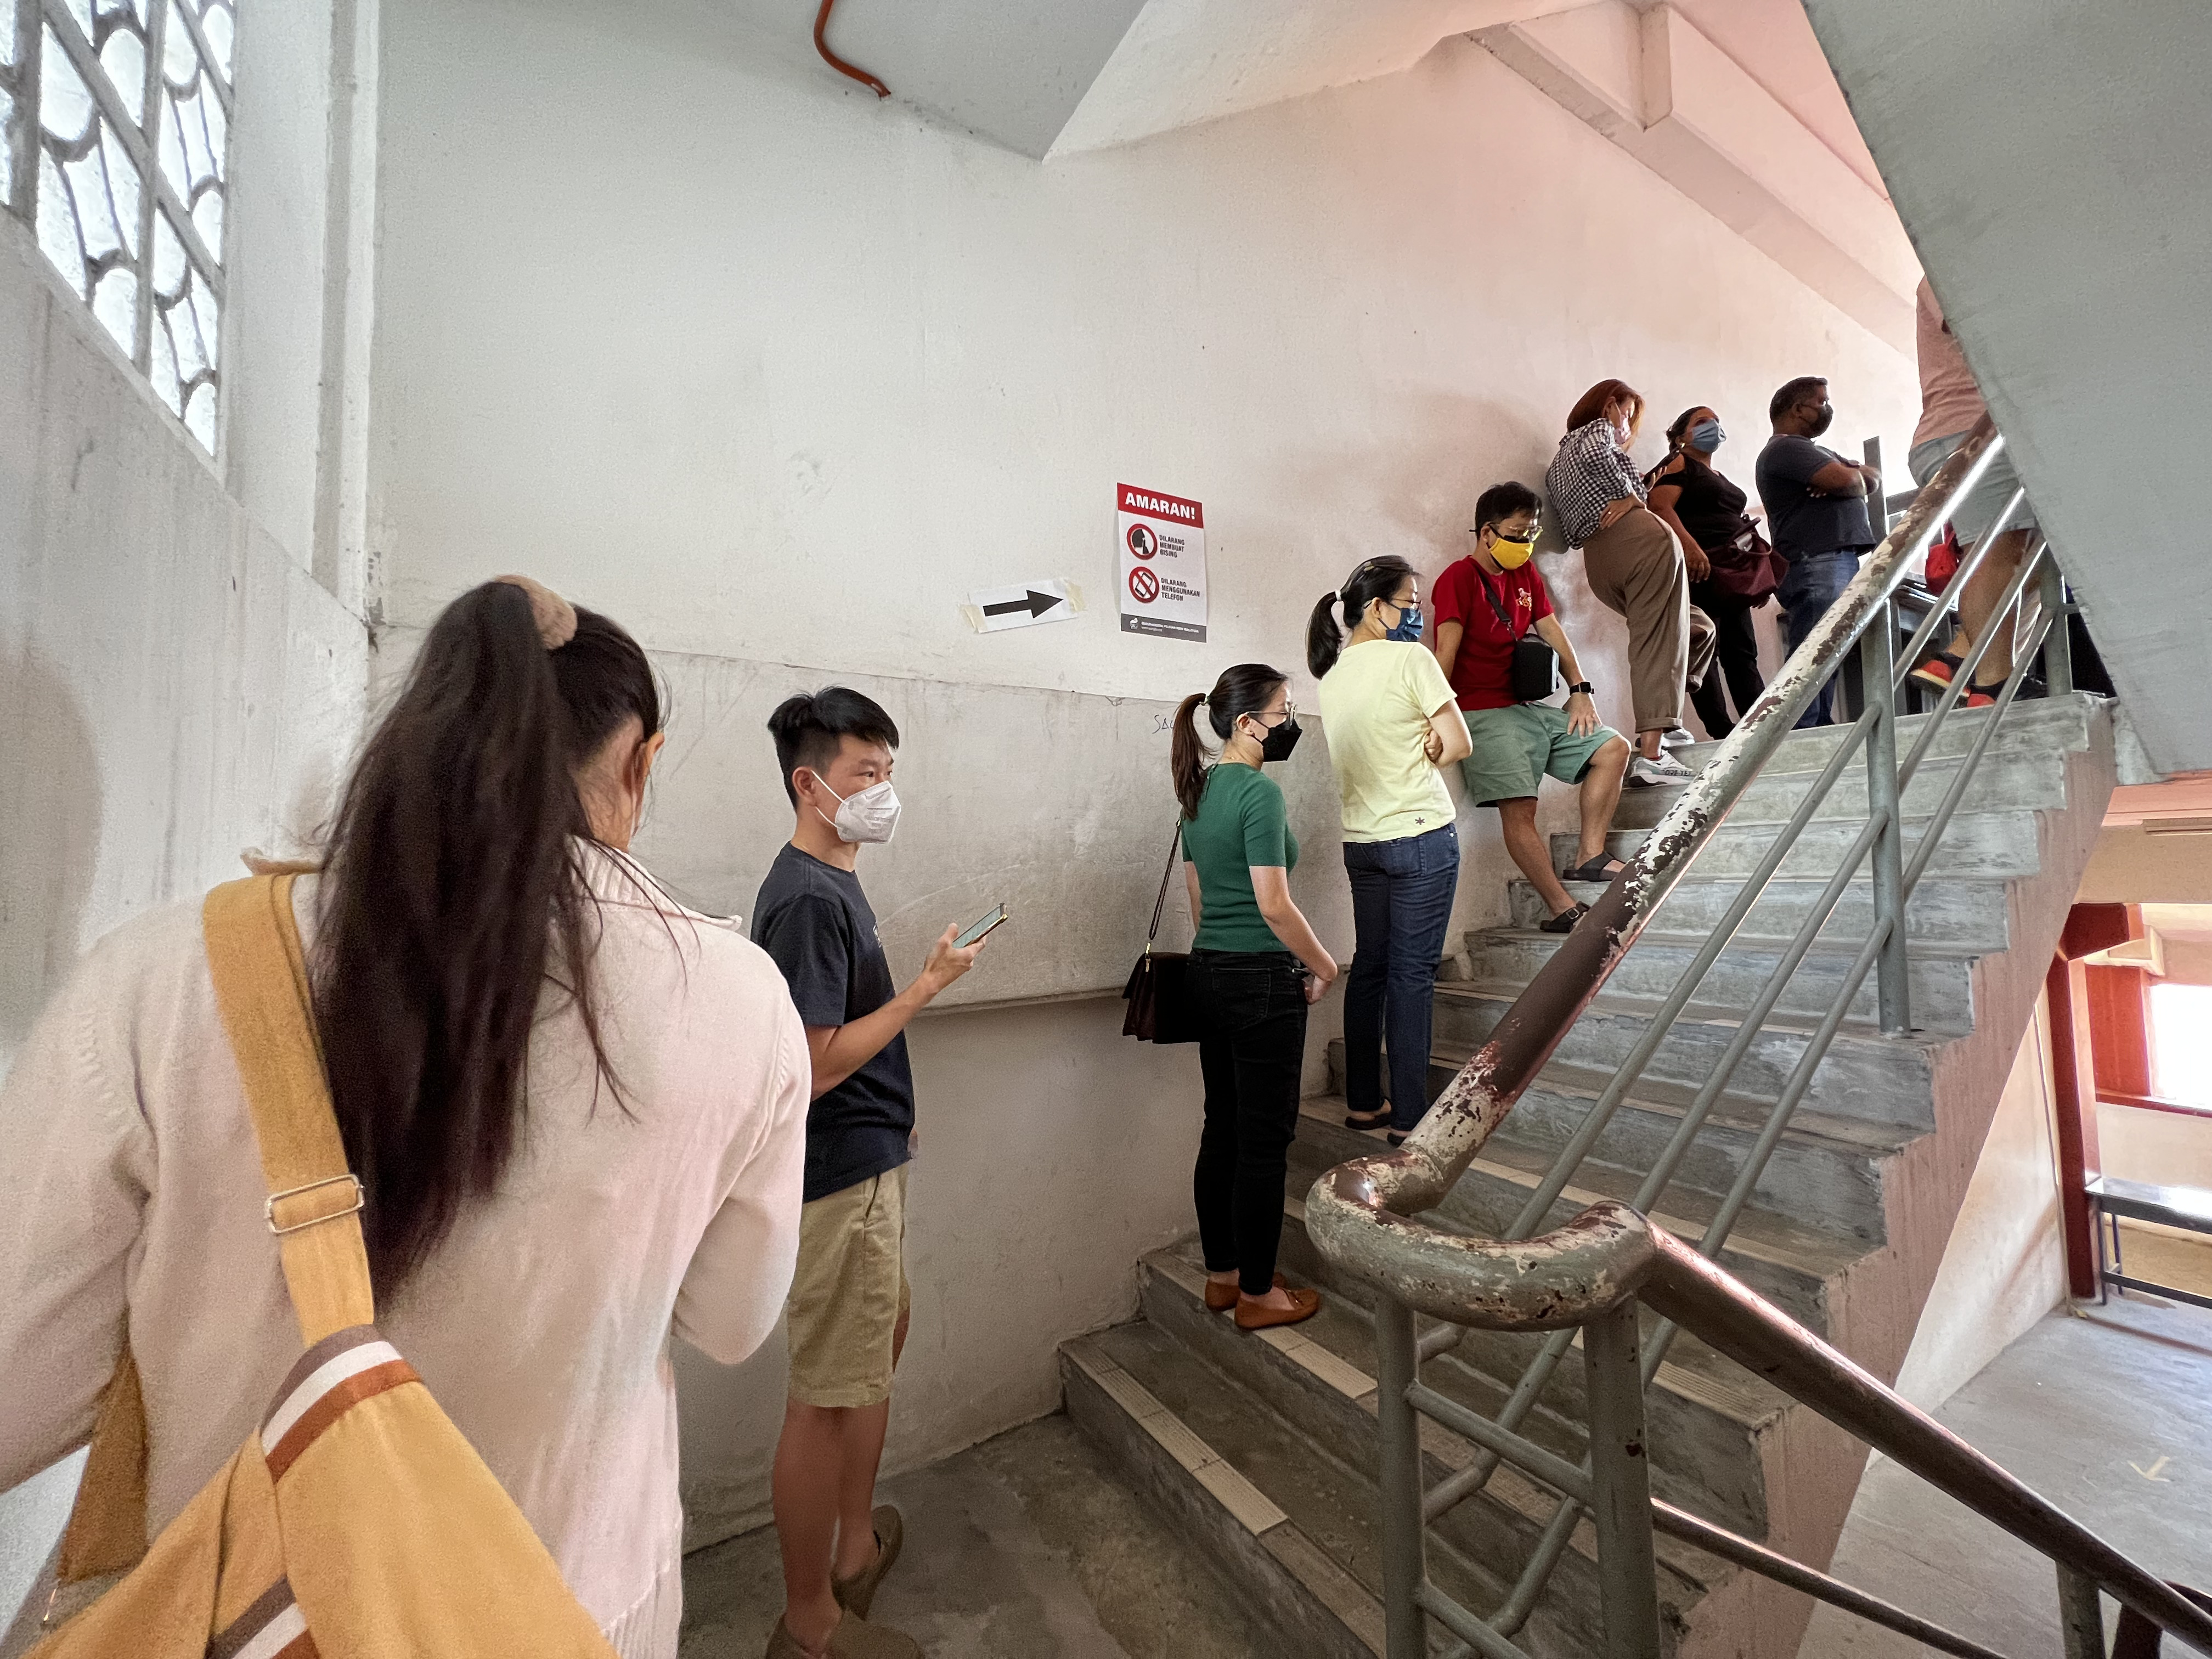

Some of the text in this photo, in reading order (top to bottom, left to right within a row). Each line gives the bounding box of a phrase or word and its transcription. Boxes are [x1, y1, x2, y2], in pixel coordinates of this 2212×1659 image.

[1125, 492, 1195, 520] AMARAN!
[1159, 535, 1184, 545] DILARANG
[1160, 542, 1184, 552] MEMBUAT
[1160, 549, 1177, 558] BISING
[1161, 578, 1187, 588] DILARANG
[1161, 585, 1200, 597] MENGGUNAKAN
[1161, 592, 1183, 601] TELEFON
